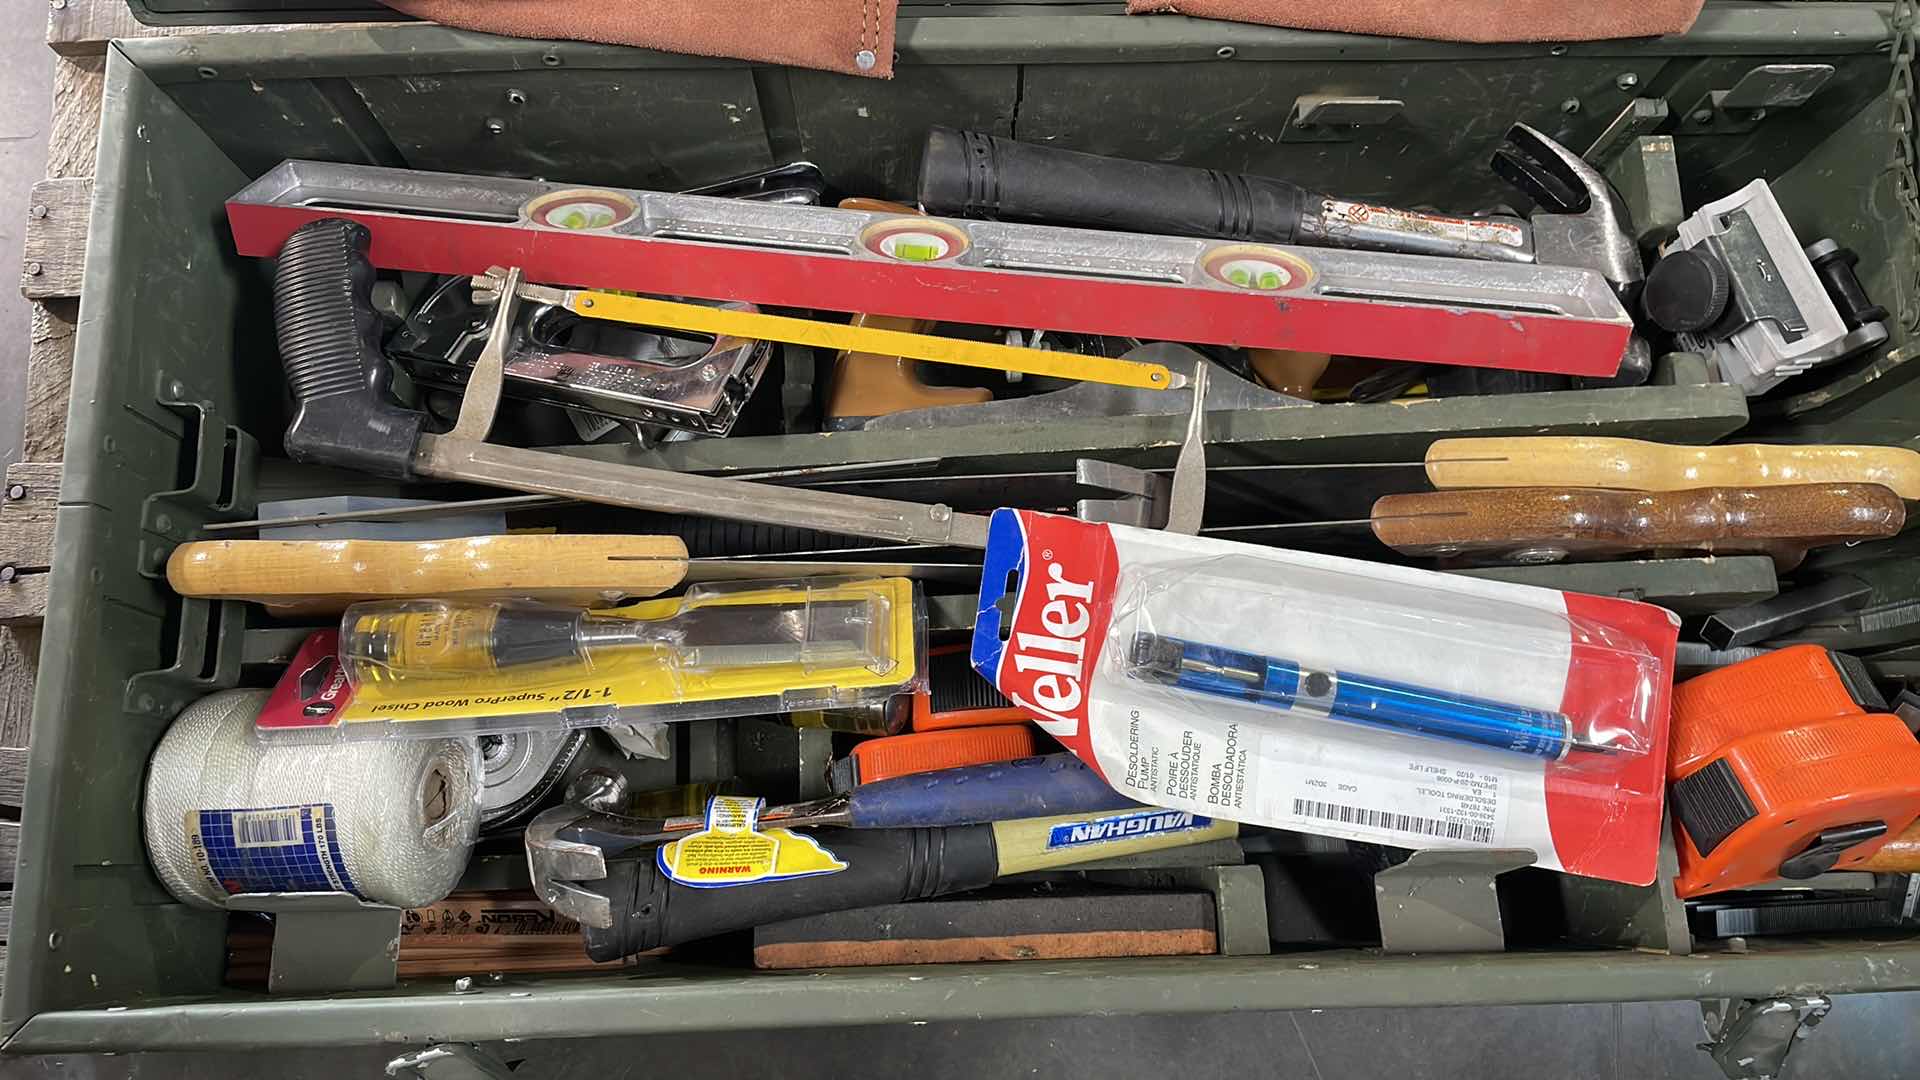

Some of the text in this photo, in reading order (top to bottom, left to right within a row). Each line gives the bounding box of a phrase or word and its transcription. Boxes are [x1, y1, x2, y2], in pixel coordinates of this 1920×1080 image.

[372, 702, 419, 713] Chisel
[424, 698, 469, 708] Wood
[475, 692, 544, 706] SuperPro
[1125, 709, 1140, 788] DESOLDERING
[1179, 730, 1193, 799] DESSOUDER
[1220, 722, 1239, 807] DESOLDADORA
[1137, 756, 1150, 790] PUMP
[1150, 746, 1160, 793] ANTISTATIC
[1166, 761, 1178, 797] POIRE
[1189, 742, 1202, 801] ANTISTATIQUE
[1207, 762, 1222, 805] BOMBA
[315, 817, 323, 835] LBS
[1070, 812, 1194, 843] VAUGHAN
[698, 865, 751, 875] WARNING
